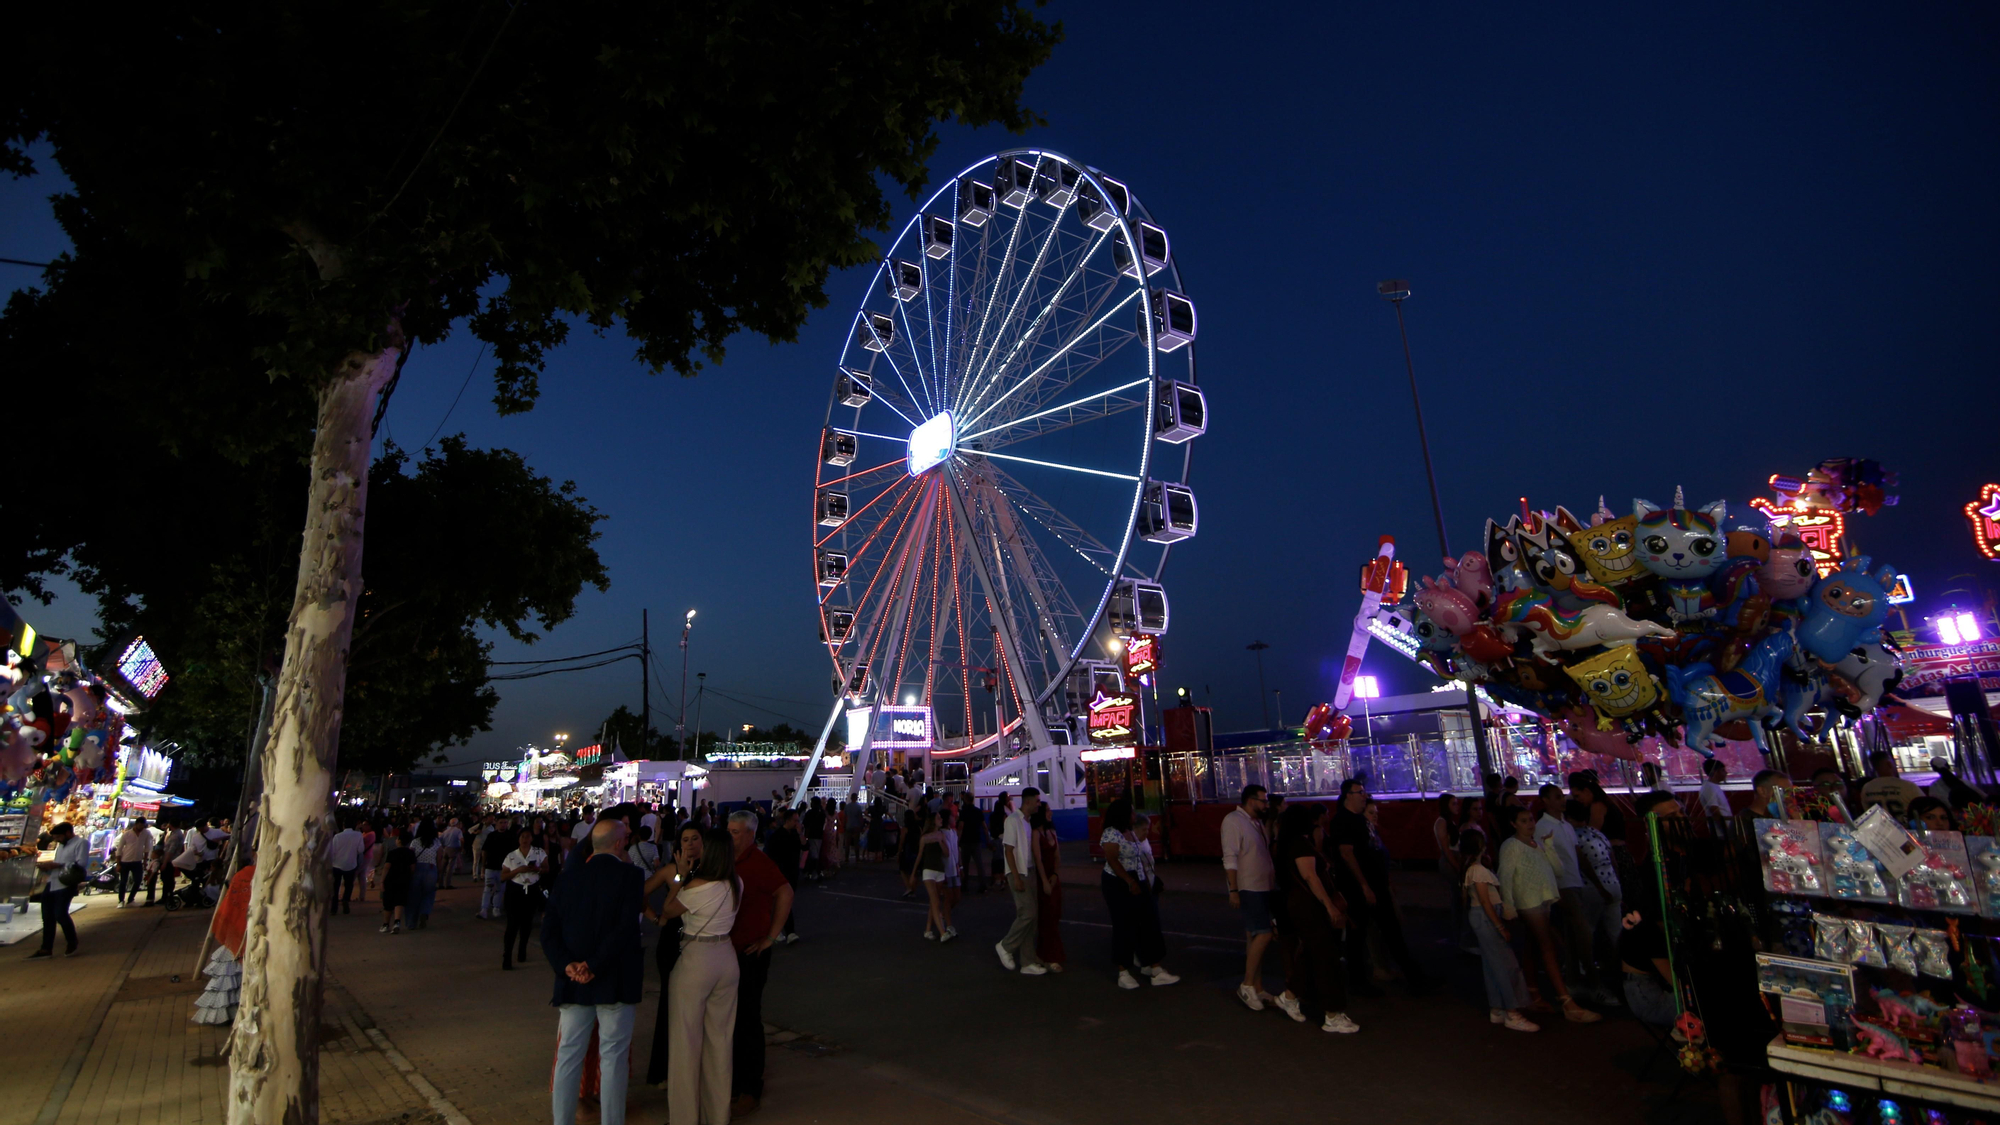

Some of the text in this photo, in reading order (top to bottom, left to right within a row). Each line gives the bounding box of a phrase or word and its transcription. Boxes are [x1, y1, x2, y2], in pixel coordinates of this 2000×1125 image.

[1128, 644, 1153, 665] IMPACT
[1090, 705, 1134, 729] IMPACT
[893, 719, 925, 737] NORIA
[483, 762, 500, 770] BUS
